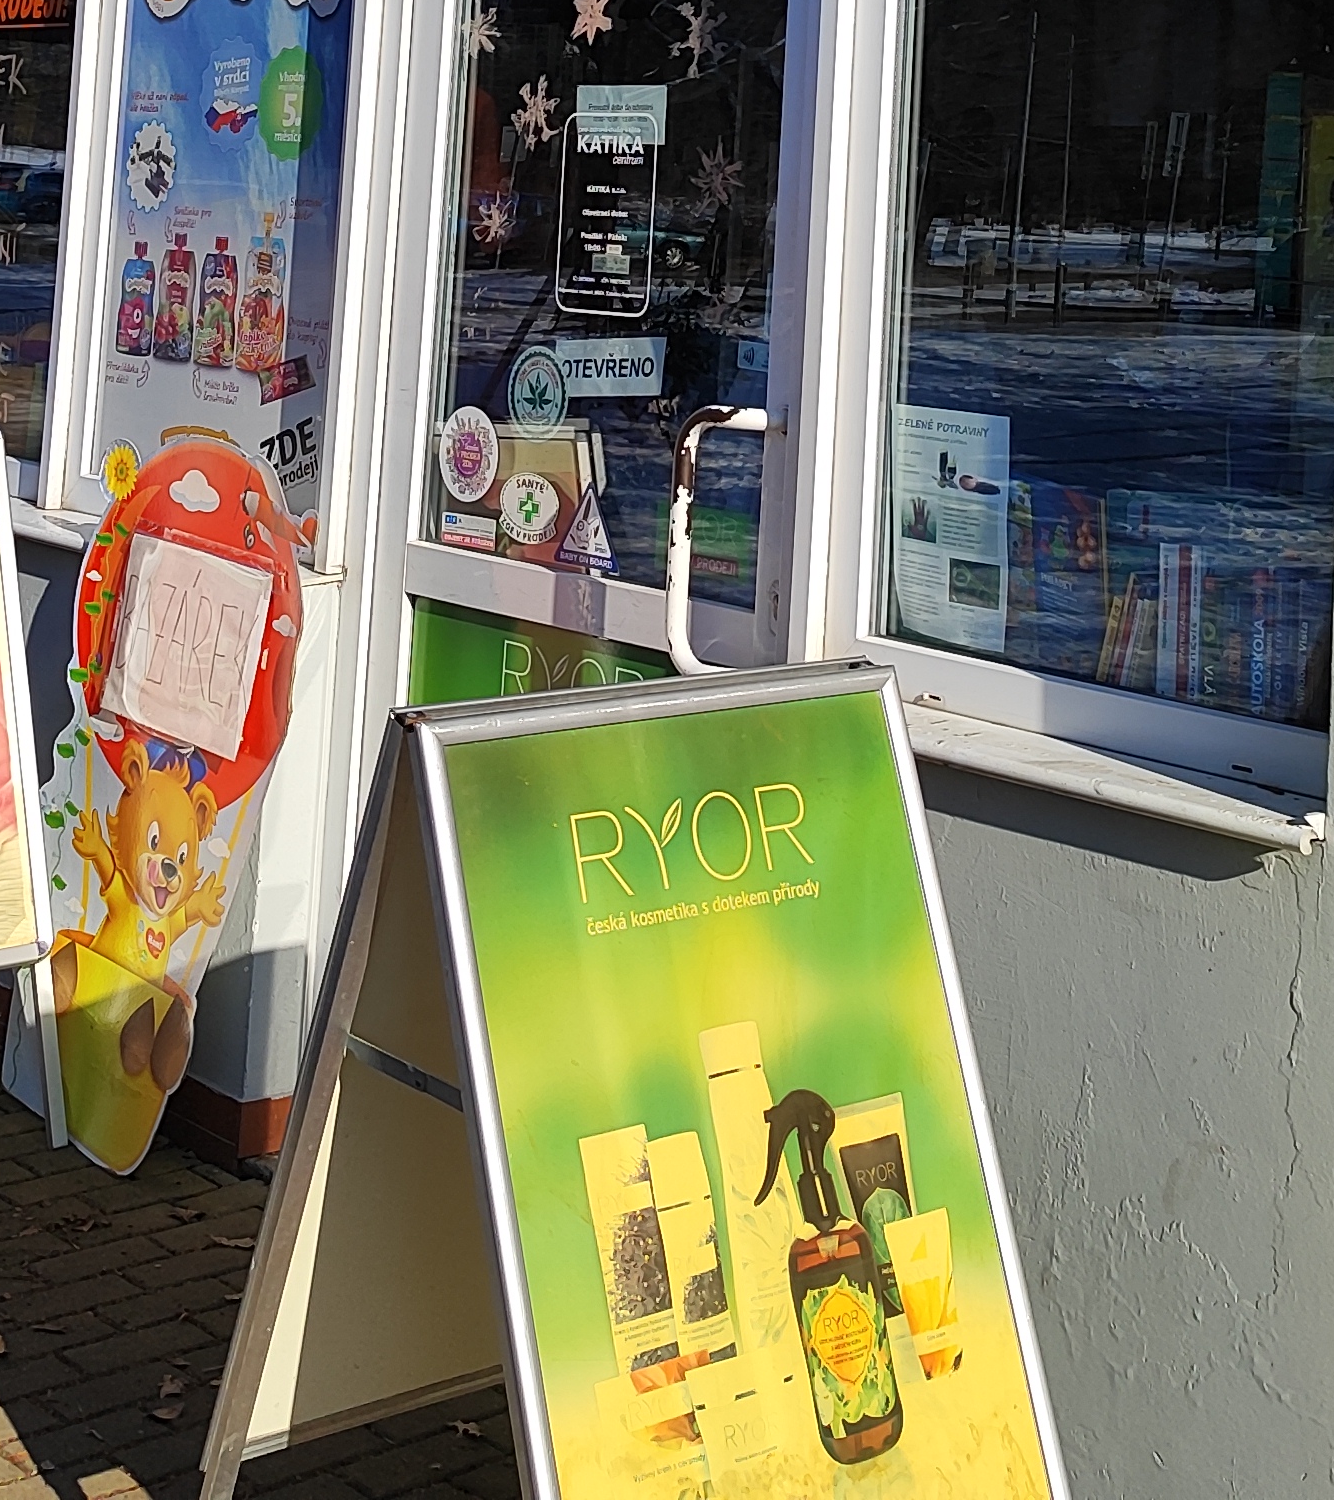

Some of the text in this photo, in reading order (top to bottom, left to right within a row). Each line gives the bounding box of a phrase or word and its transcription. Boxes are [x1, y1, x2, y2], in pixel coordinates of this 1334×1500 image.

[223, 68, 250, 86] srdci
[577, 134, 644, 154] KATIKA
[564, 352, 654, 379] OTEVŘENO
[898, 417, 934, 431] ZELENÉ
[937, 421, 990, 439] POTRAVINY
[260, 416, 317, 470] ZDE
[500, 516, 516, 537] ZDE
[522, 522, 556, 545] PRODEJI
[589, 555, 613, 569] BOARD
[115, 569, 260, 713] BAZÁREK
[1298, 621, 1309, 653] Vista
[570, 783, 815, 904] RYOR
[586, 876, 820, 936] česká kosmetika s dotekem přírody
[855, 1161, 899, 1188] RYOR
[823, 1309, 860, 1334] RYOR
